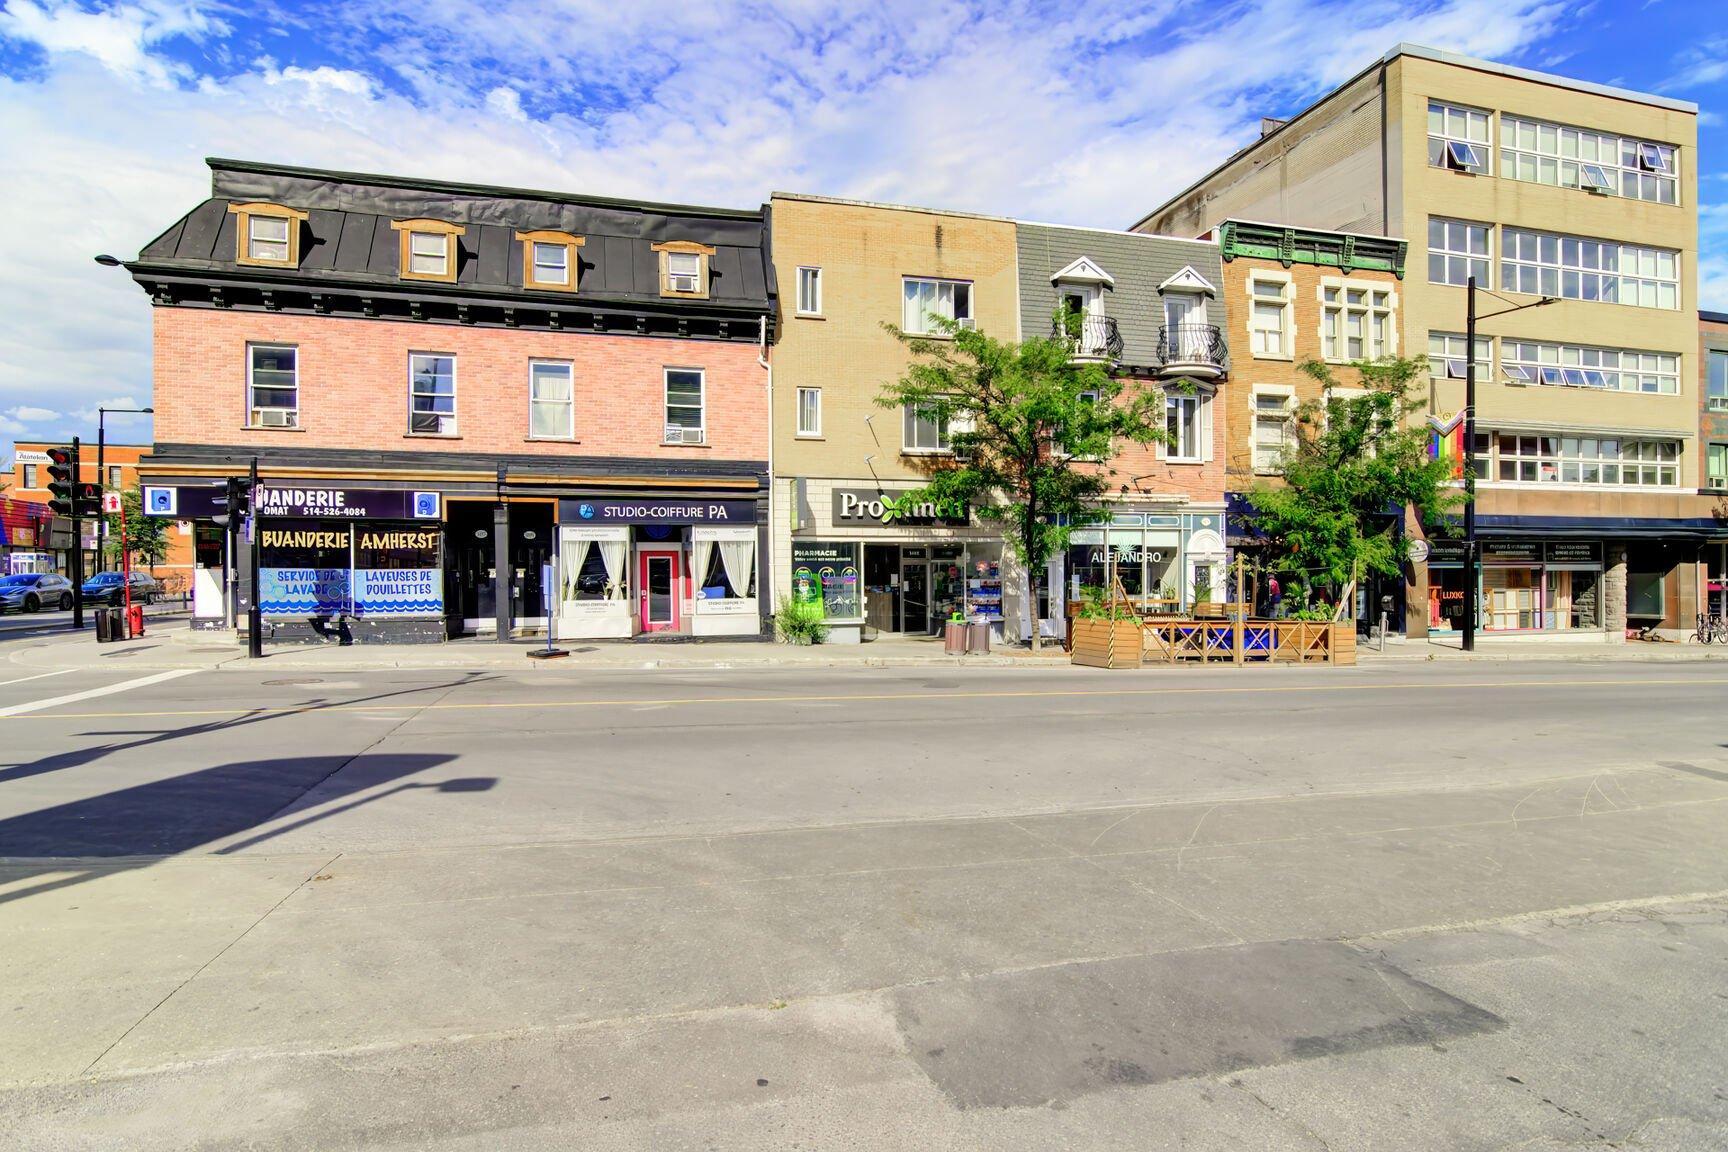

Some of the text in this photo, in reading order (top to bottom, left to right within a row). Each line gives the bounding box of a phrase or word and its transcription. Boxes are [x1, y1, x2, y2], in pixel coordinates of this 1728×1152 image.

[263, 489, 345, 507] ANDERIE
[263, 506, 367, 516] OMAT 514-526-4084
[604, 505, 728, 519] STUDIO-COIFFURE PA
[262, 531, 437, 549] BUANDERIE AMHERST
[1091, 551, 1162, 563] ALEJANDRO
[277, 570, 320, 582] SERVICE
[365, 570, 432, 582] LAVEUSES DE
[366, 583, 432, 596] DOUILLETTES
